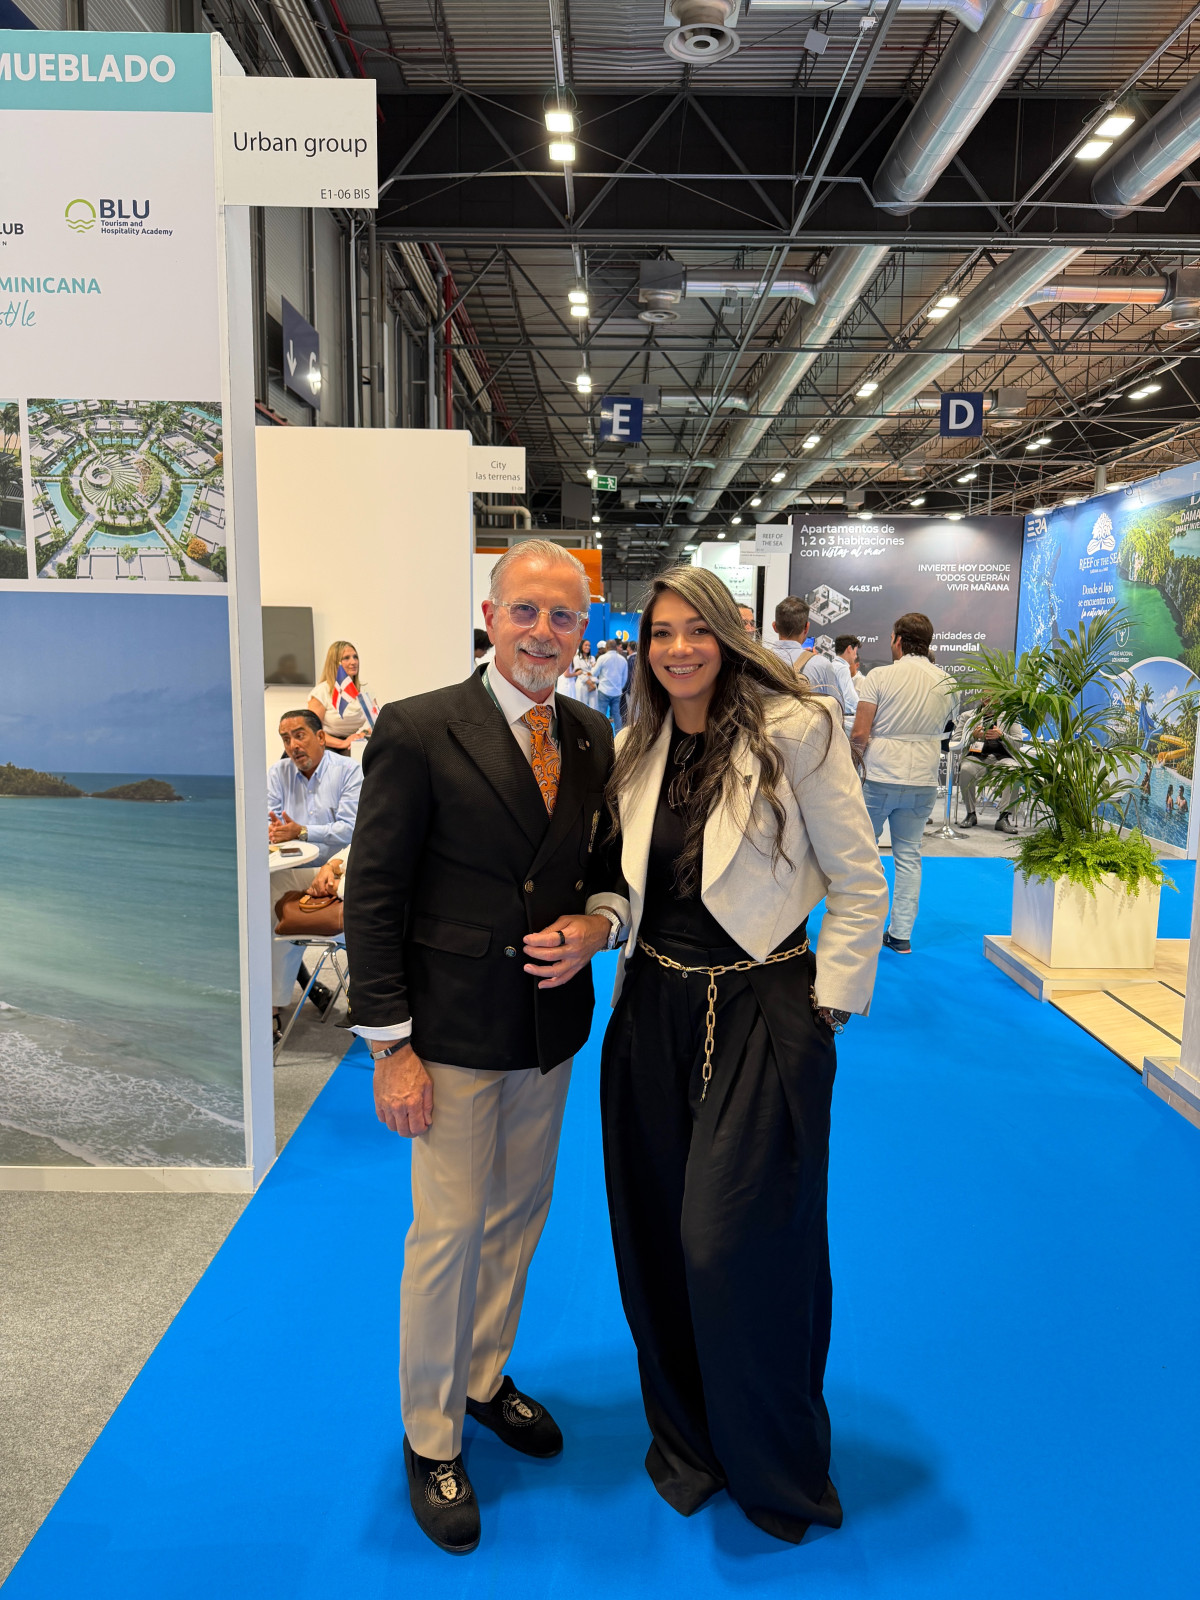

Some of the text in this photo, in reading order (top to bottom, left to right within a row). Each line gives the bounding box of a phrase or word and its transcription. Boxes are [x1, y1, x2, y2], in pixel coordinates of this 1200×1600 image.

[233, 131, 368, 158] Urban group
[320, 189, 371, 201] E1-06 BIS
[99, 199, 150, 219] BLU
[0, 223, 24, 235] UB
[101, 228, 173, 237] Hospitality Academy
[612, 403, 632, 436] E
[948, 399, 975, 430] D
[490, 460, 507, 471] City
[475, 471, 521, 481] las terrenas
[800, 524, 895, 535] Apartamentos de
[800, 535, 905, 546] 1, 2 o 3 habitaciones
[800, 549, 820, 557] con
[1079, 556, 1095, 571] REEF
[1094, 558, 1100, 567] OF
[1100, 556, 1109, 566] THE
[1109, 552, 1121, 565] SEA
[918, 564, 1011, 572] INVIERTE HOY DONDE
[936, 572, 1010, 582] TODOS QUERRÁN
[947, 582, 1010, 591] VIVIR MAÑANA
[973, 631, 986, 640] de
[940, 642, 980, 652] mundial
